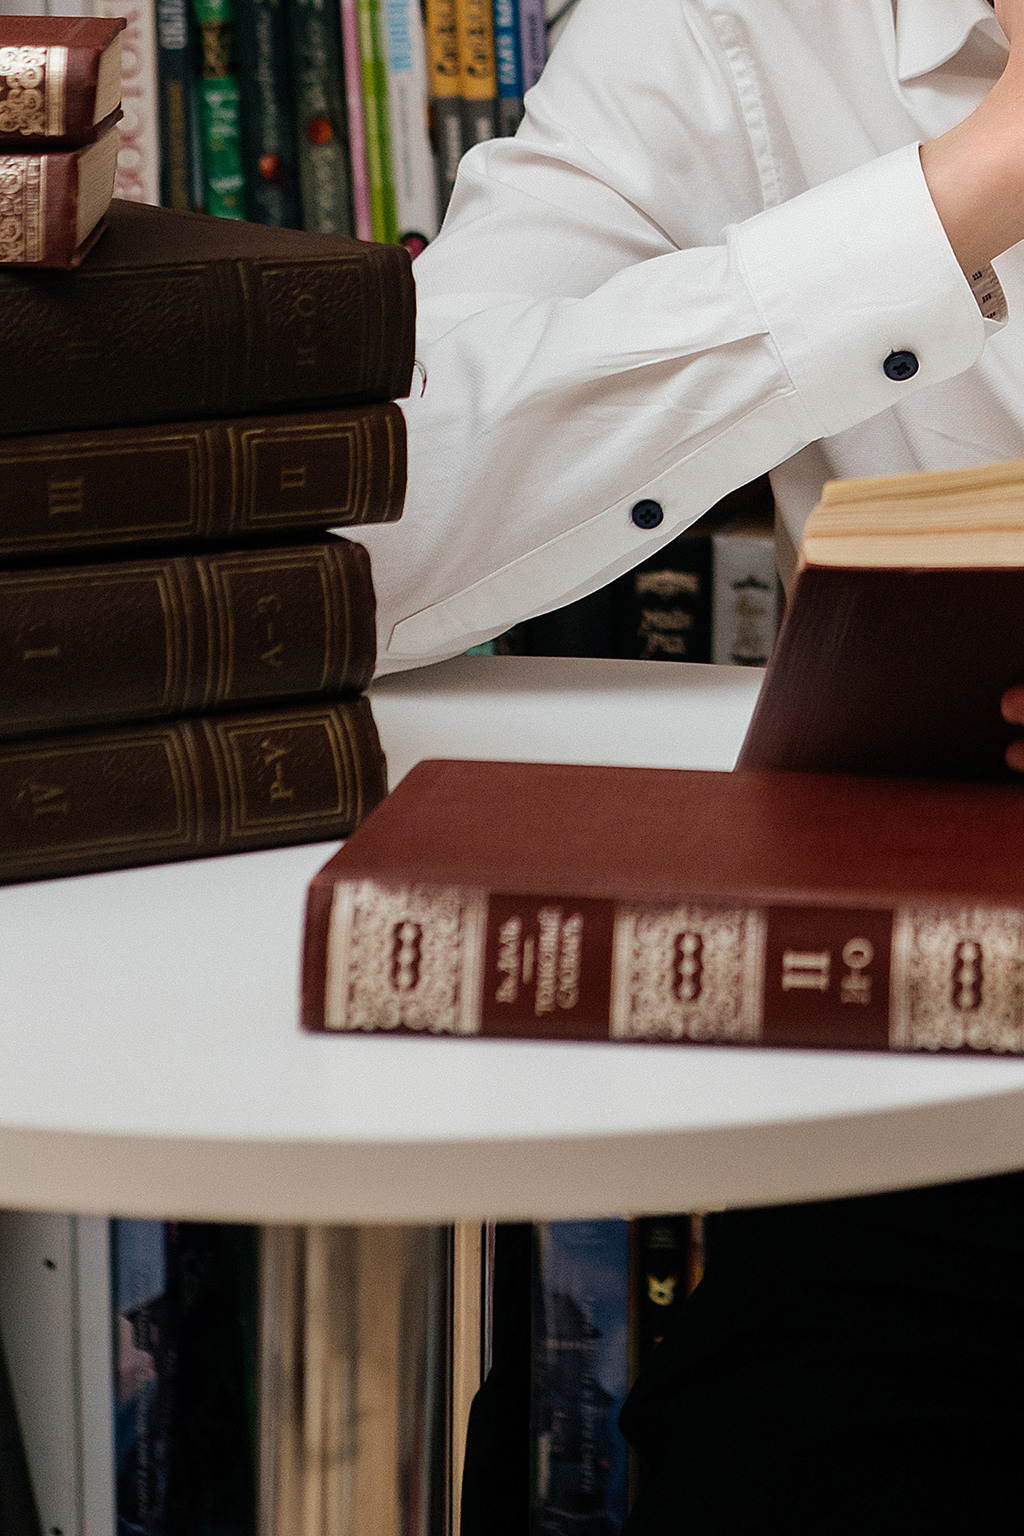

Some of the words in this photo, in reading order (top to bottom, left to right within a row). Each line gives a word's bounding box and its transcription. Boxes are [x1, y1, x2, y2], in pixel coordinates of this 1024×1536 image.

[48, 475, 84, 516] III
[28, 783, 68, 816] IV
[535, 905, 564, 1017] ТОЛКОВЫЙ
[556, 911, 584, 1011] СЛОВАРЬ
[782, 949, 831, 992] II
